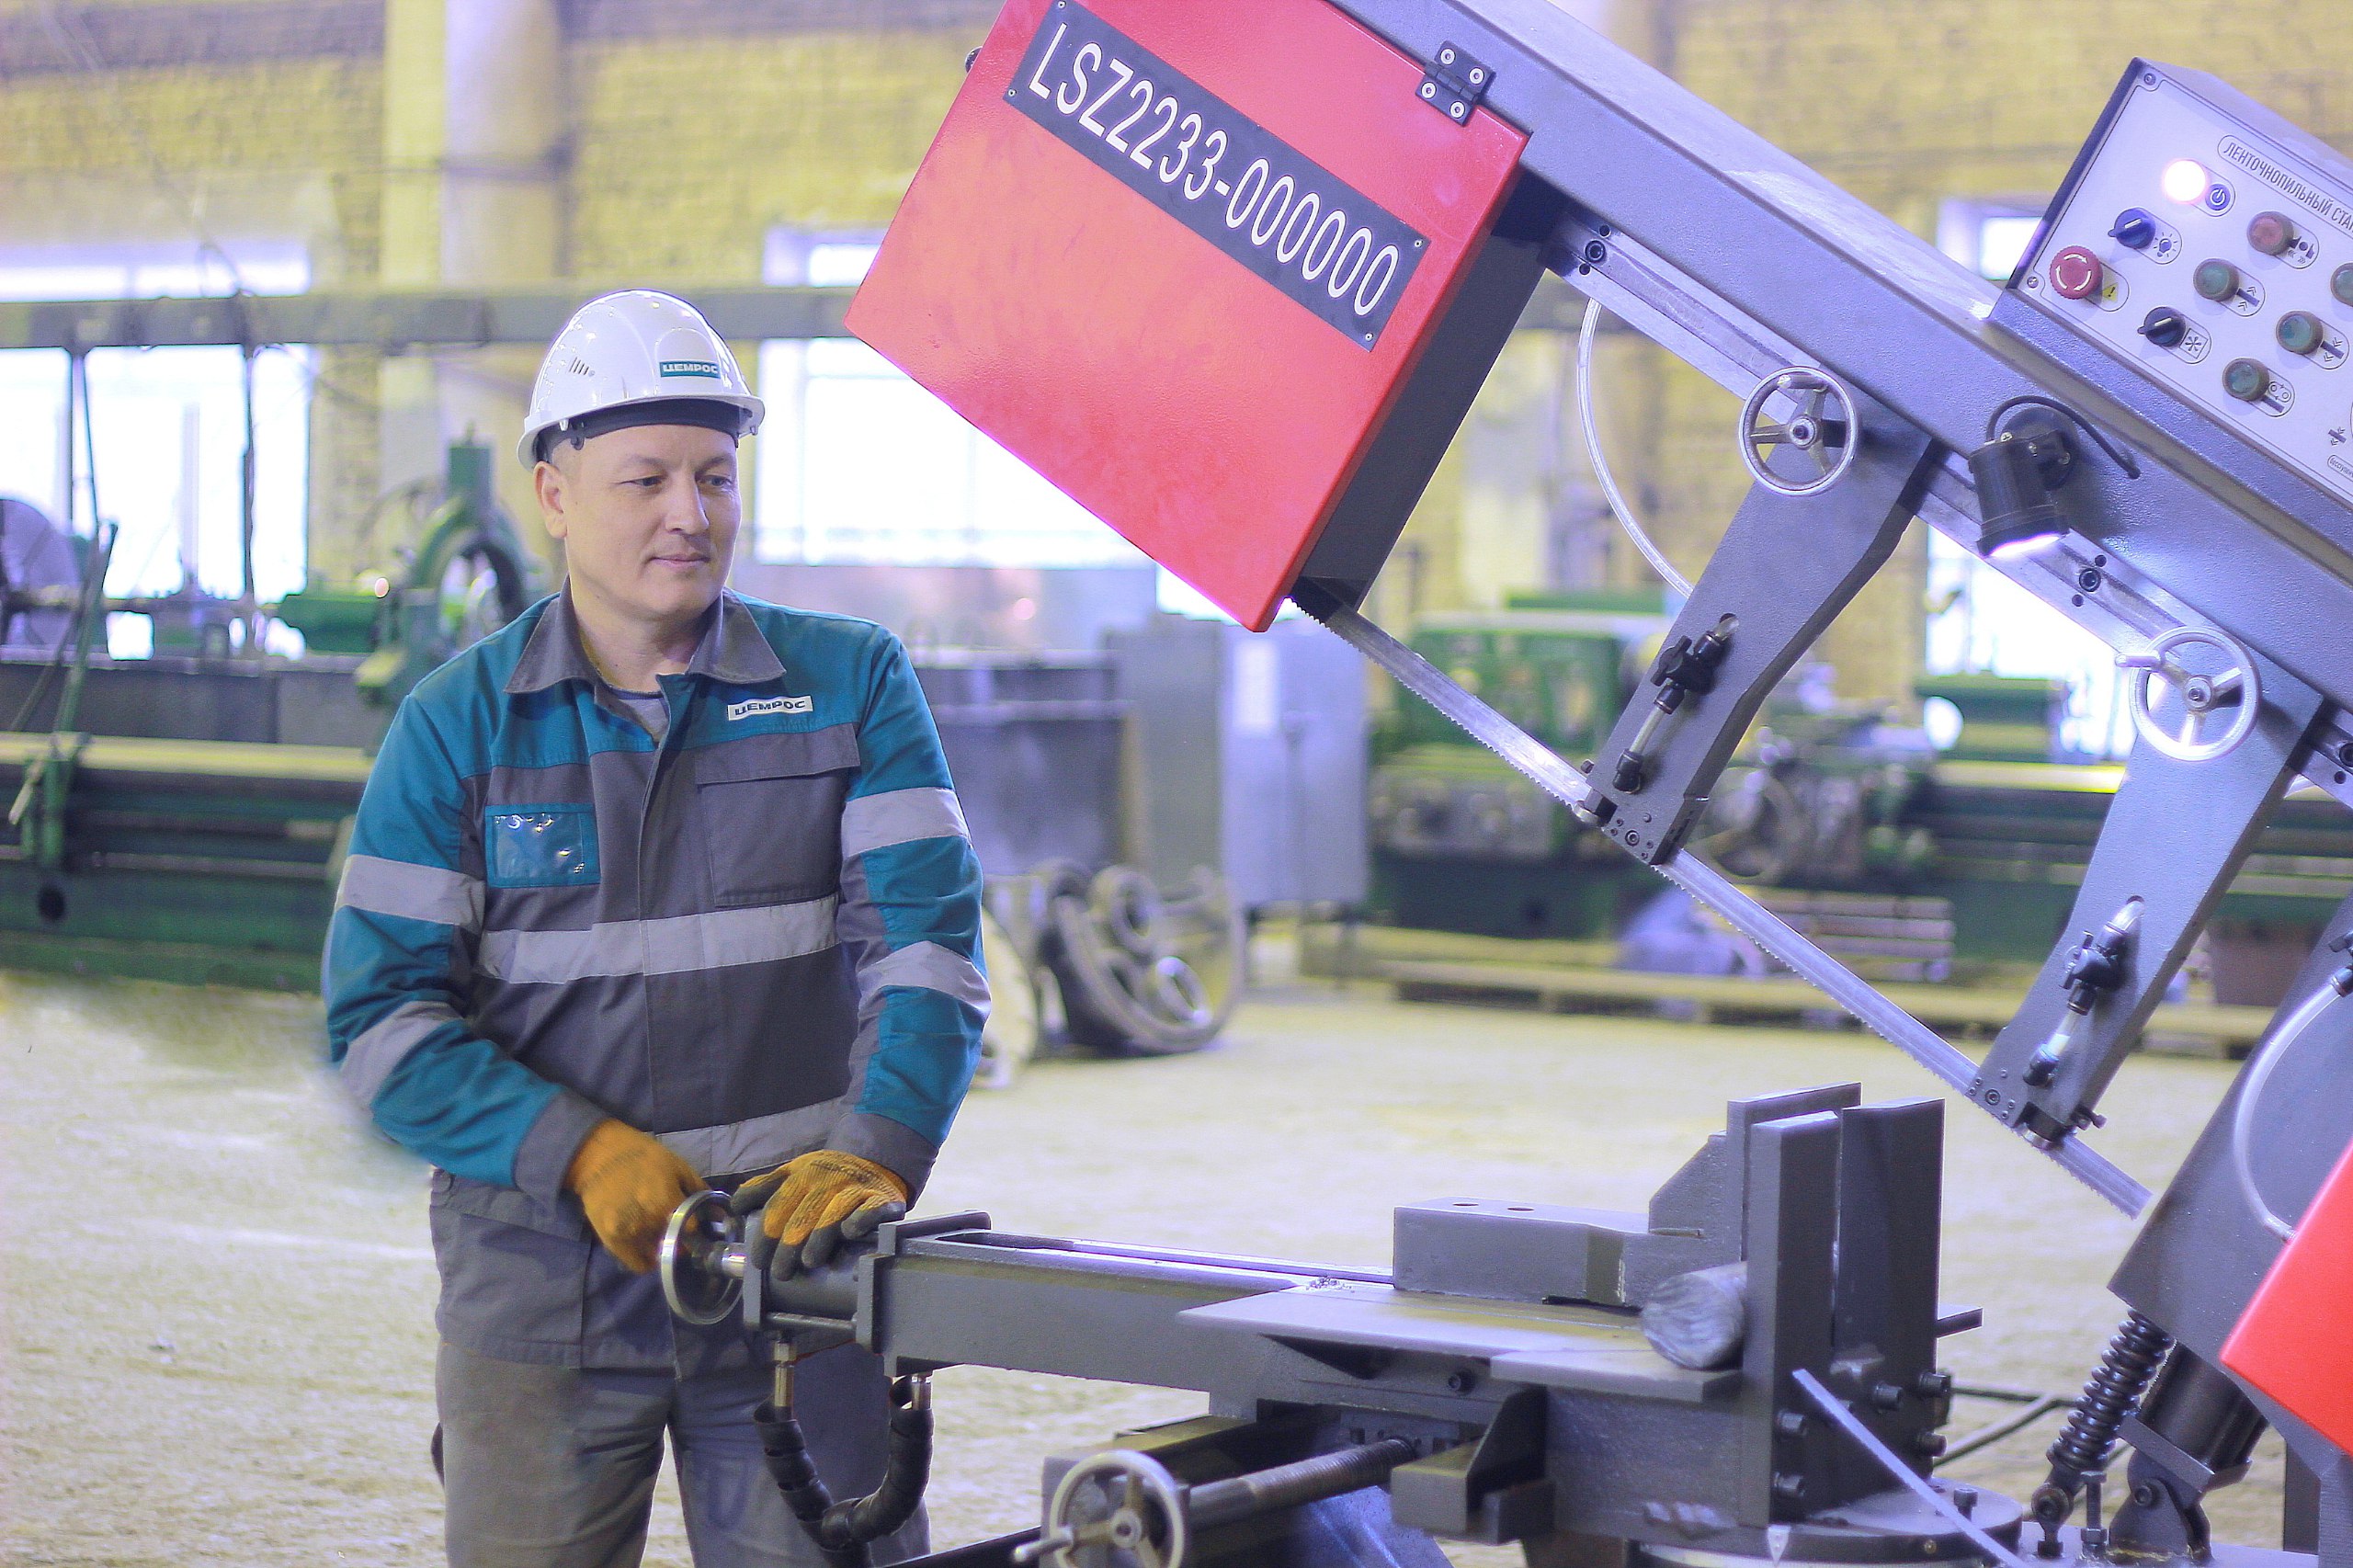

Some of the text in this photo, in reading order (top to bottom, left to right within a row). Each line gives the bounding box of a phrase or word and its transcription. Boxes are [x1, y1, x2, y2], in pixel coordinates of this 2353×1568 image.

[1029, 22, 1399, 316] LSZ2233-00000
[2223, 142, 2334, 216] ЛЕНТОЧНОПИЛЬНЫЙ
[663, 363, 719, 374] ЦЕМРОС
[734, 700, 806, 715] ЦЕМРОС
